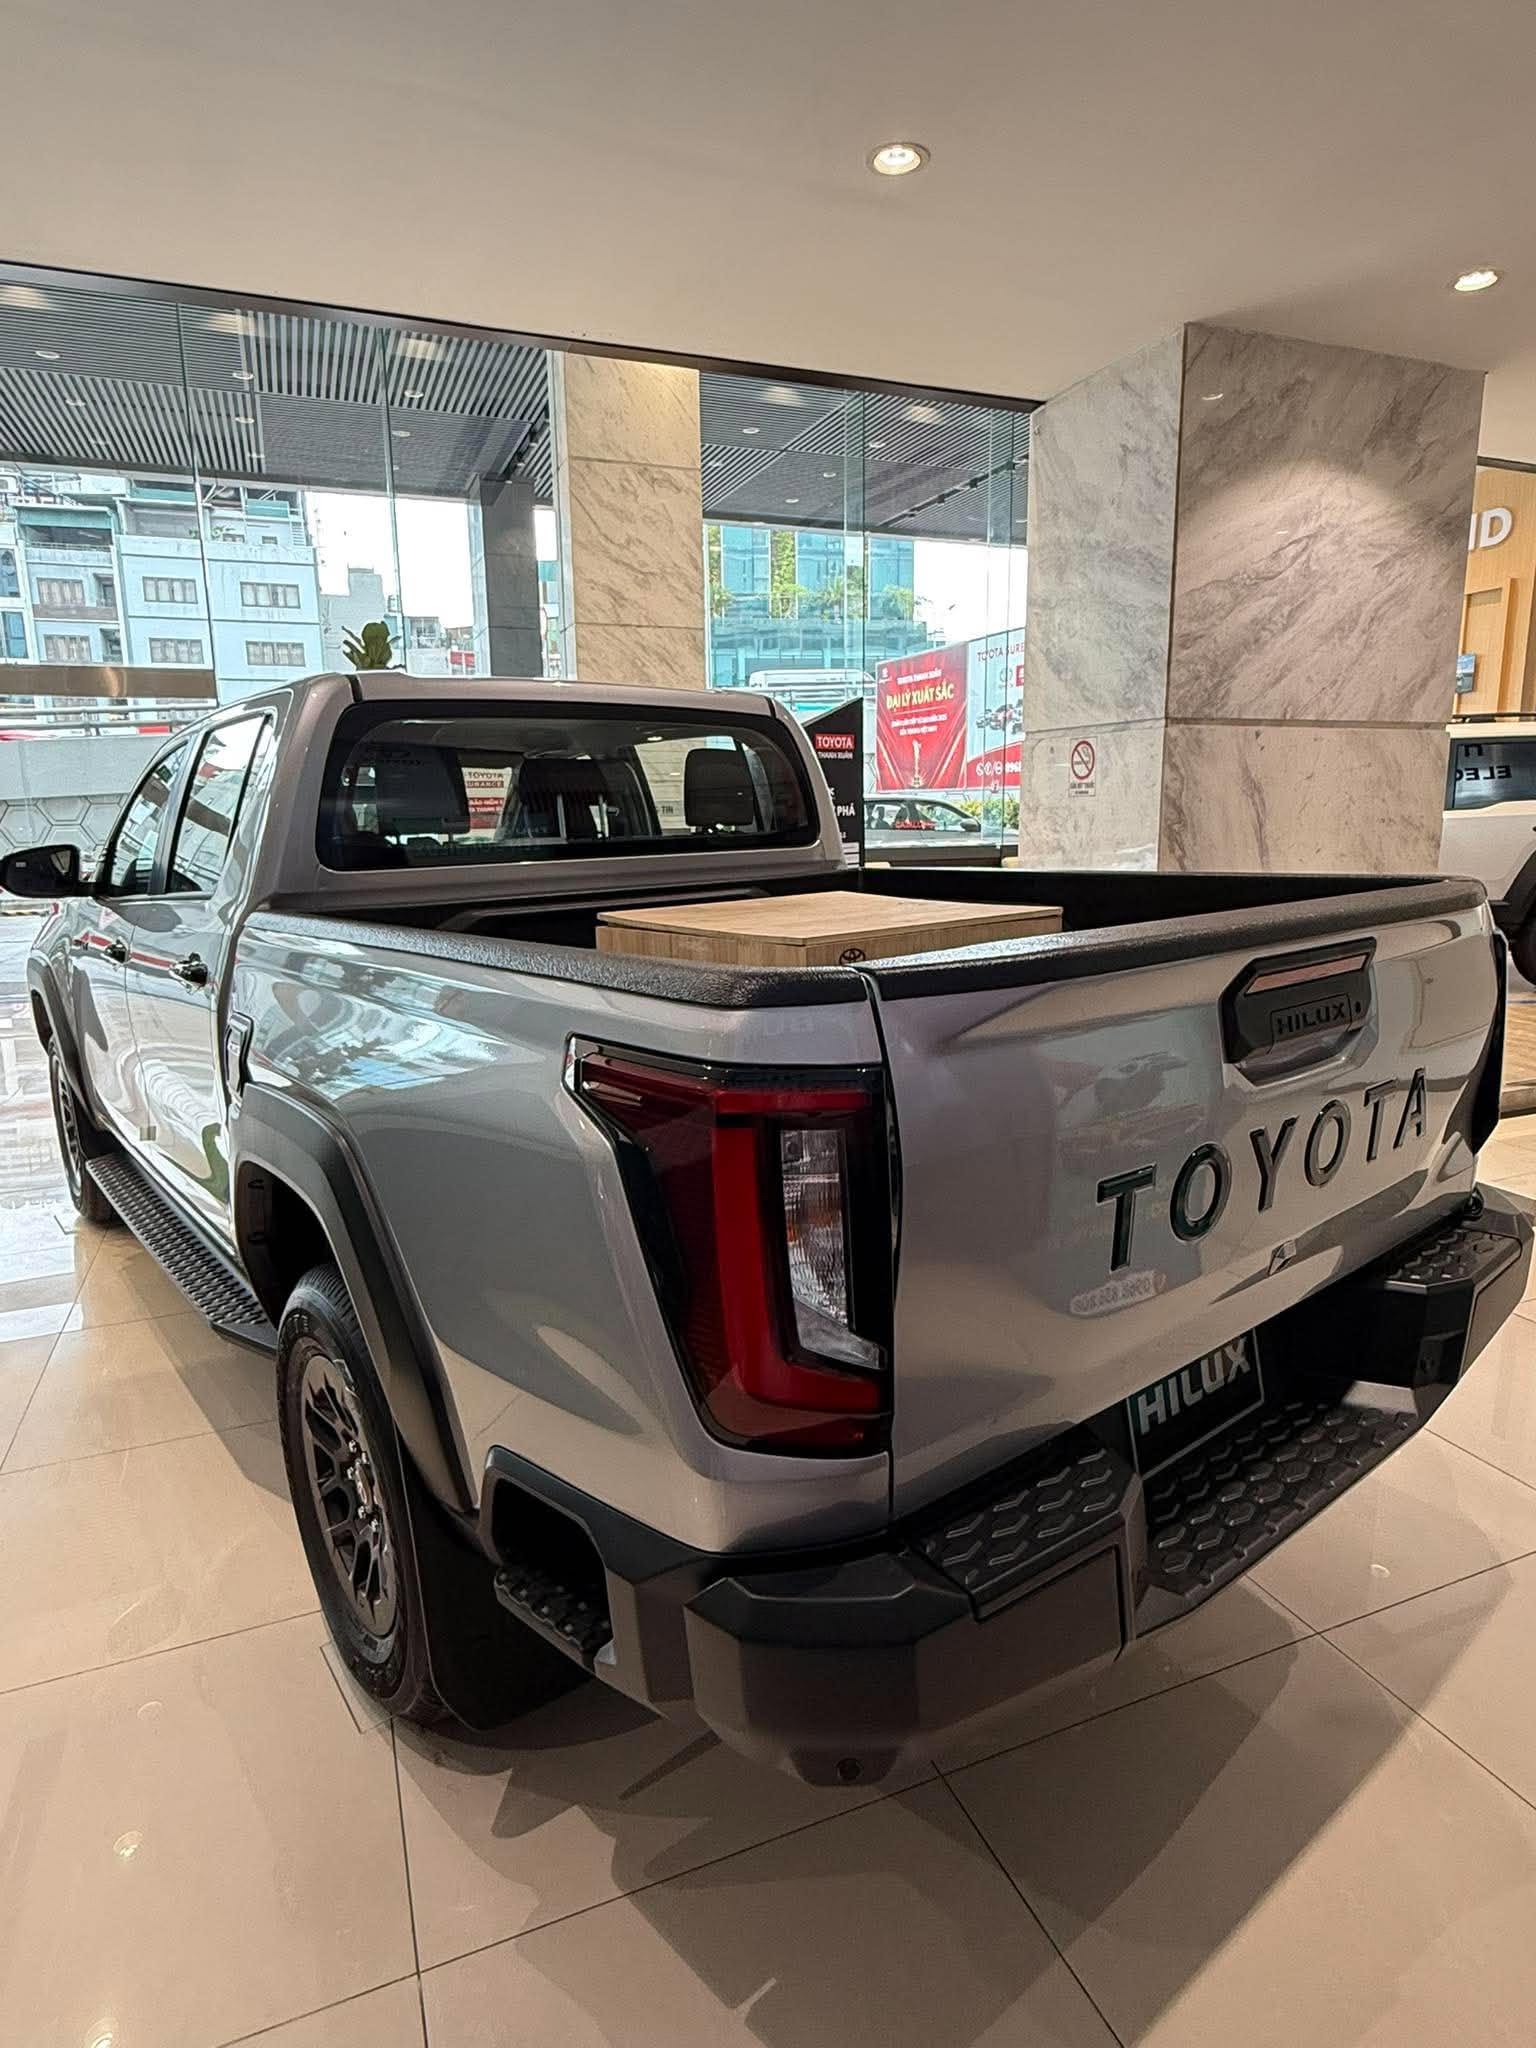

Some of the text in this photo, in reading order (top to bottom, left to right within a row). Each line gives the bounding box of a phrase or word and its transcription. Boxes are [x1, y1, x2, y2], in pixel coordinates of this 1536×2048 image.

[1006, 642, 1024, 656] URE
[817, 736, 853, 749] TOYOTA
[467, 771, 504, 779] TOYOTA
[837, 803, 855, 816] PHÁ
[1277, 1002, 1345, 1035] HILUX
[1096, 1066, 1427, 1272] TOYOTA
[1137, 1336, 1251, 1436] HILUX
